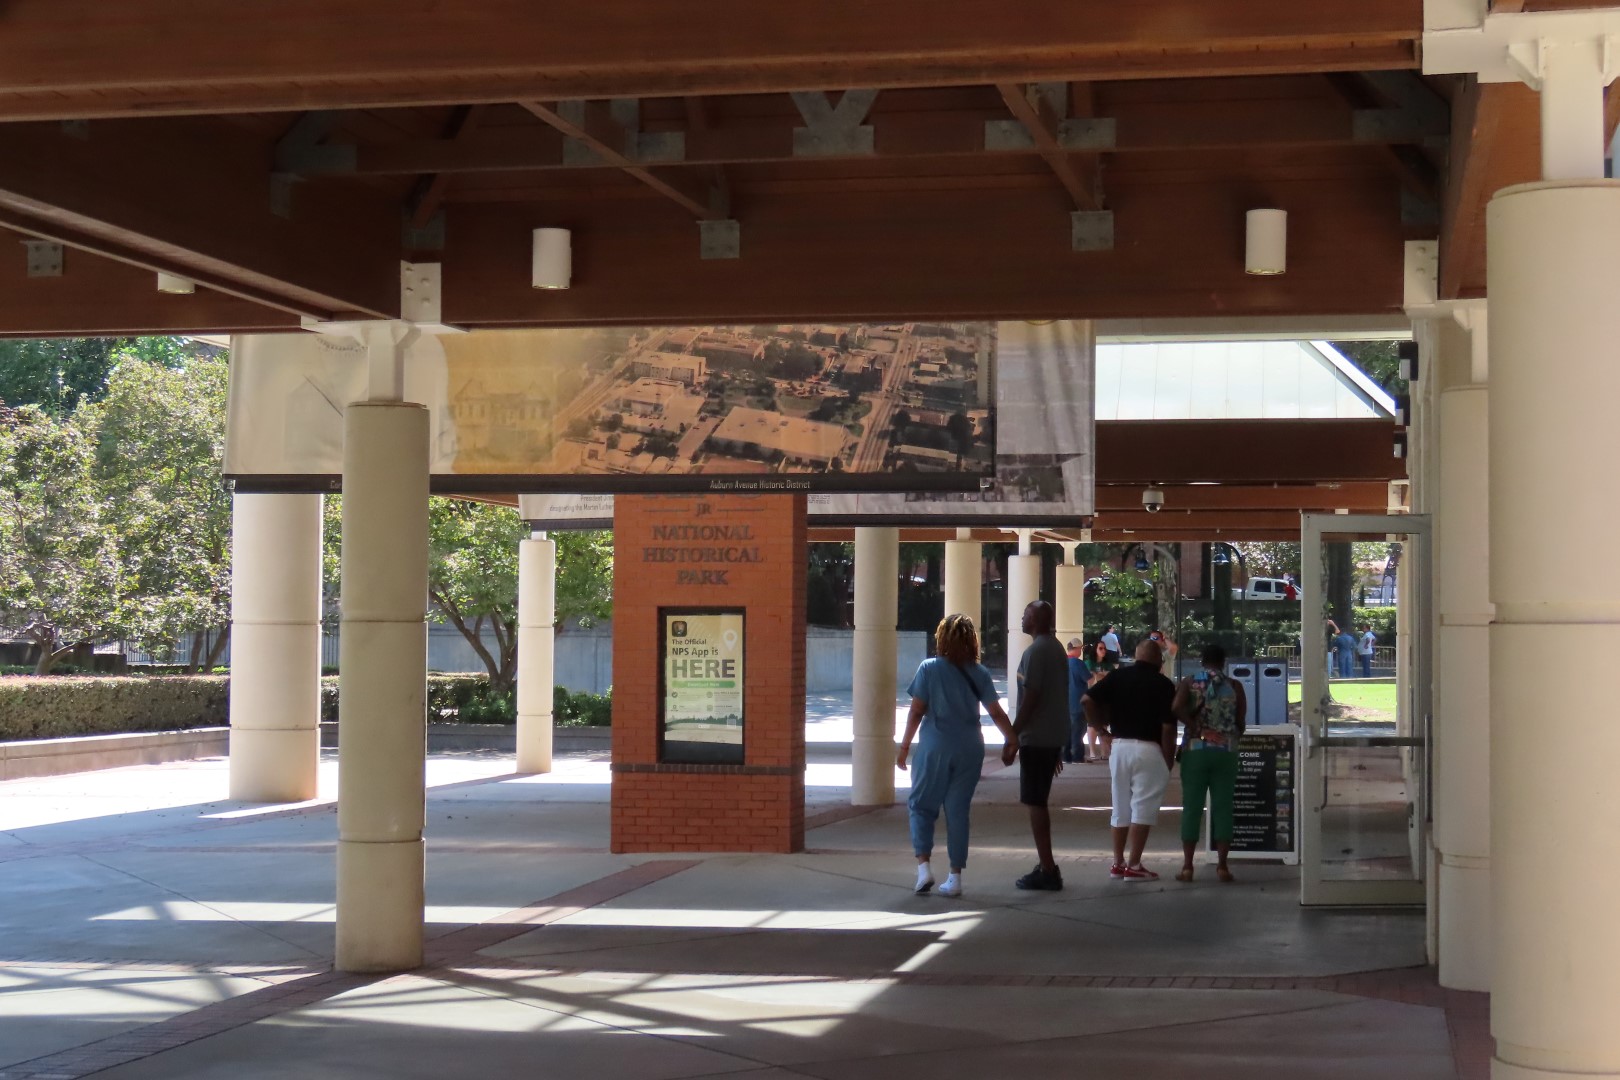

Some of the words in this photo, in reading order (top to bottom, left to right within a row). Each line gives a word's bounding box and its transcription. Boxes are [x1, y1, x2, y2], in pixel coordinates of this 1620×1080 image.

[710, 480, 733, 489] Auburn
[734, 480, 758, 489] Avenue
[760, 480, 784, 489] Historic
[786, 480, 810, 489] District
[652, 525, 754, 540] NATIONAL
[642, 547, 764, 562] HISTORICAL
[676, 570, 728, 585] PARK
[672, 648, 690, 656] NPS
[691, 648, 709, 658] App
[711, 647, 719, 656] is
[671, 659, 736, 678] HERE
